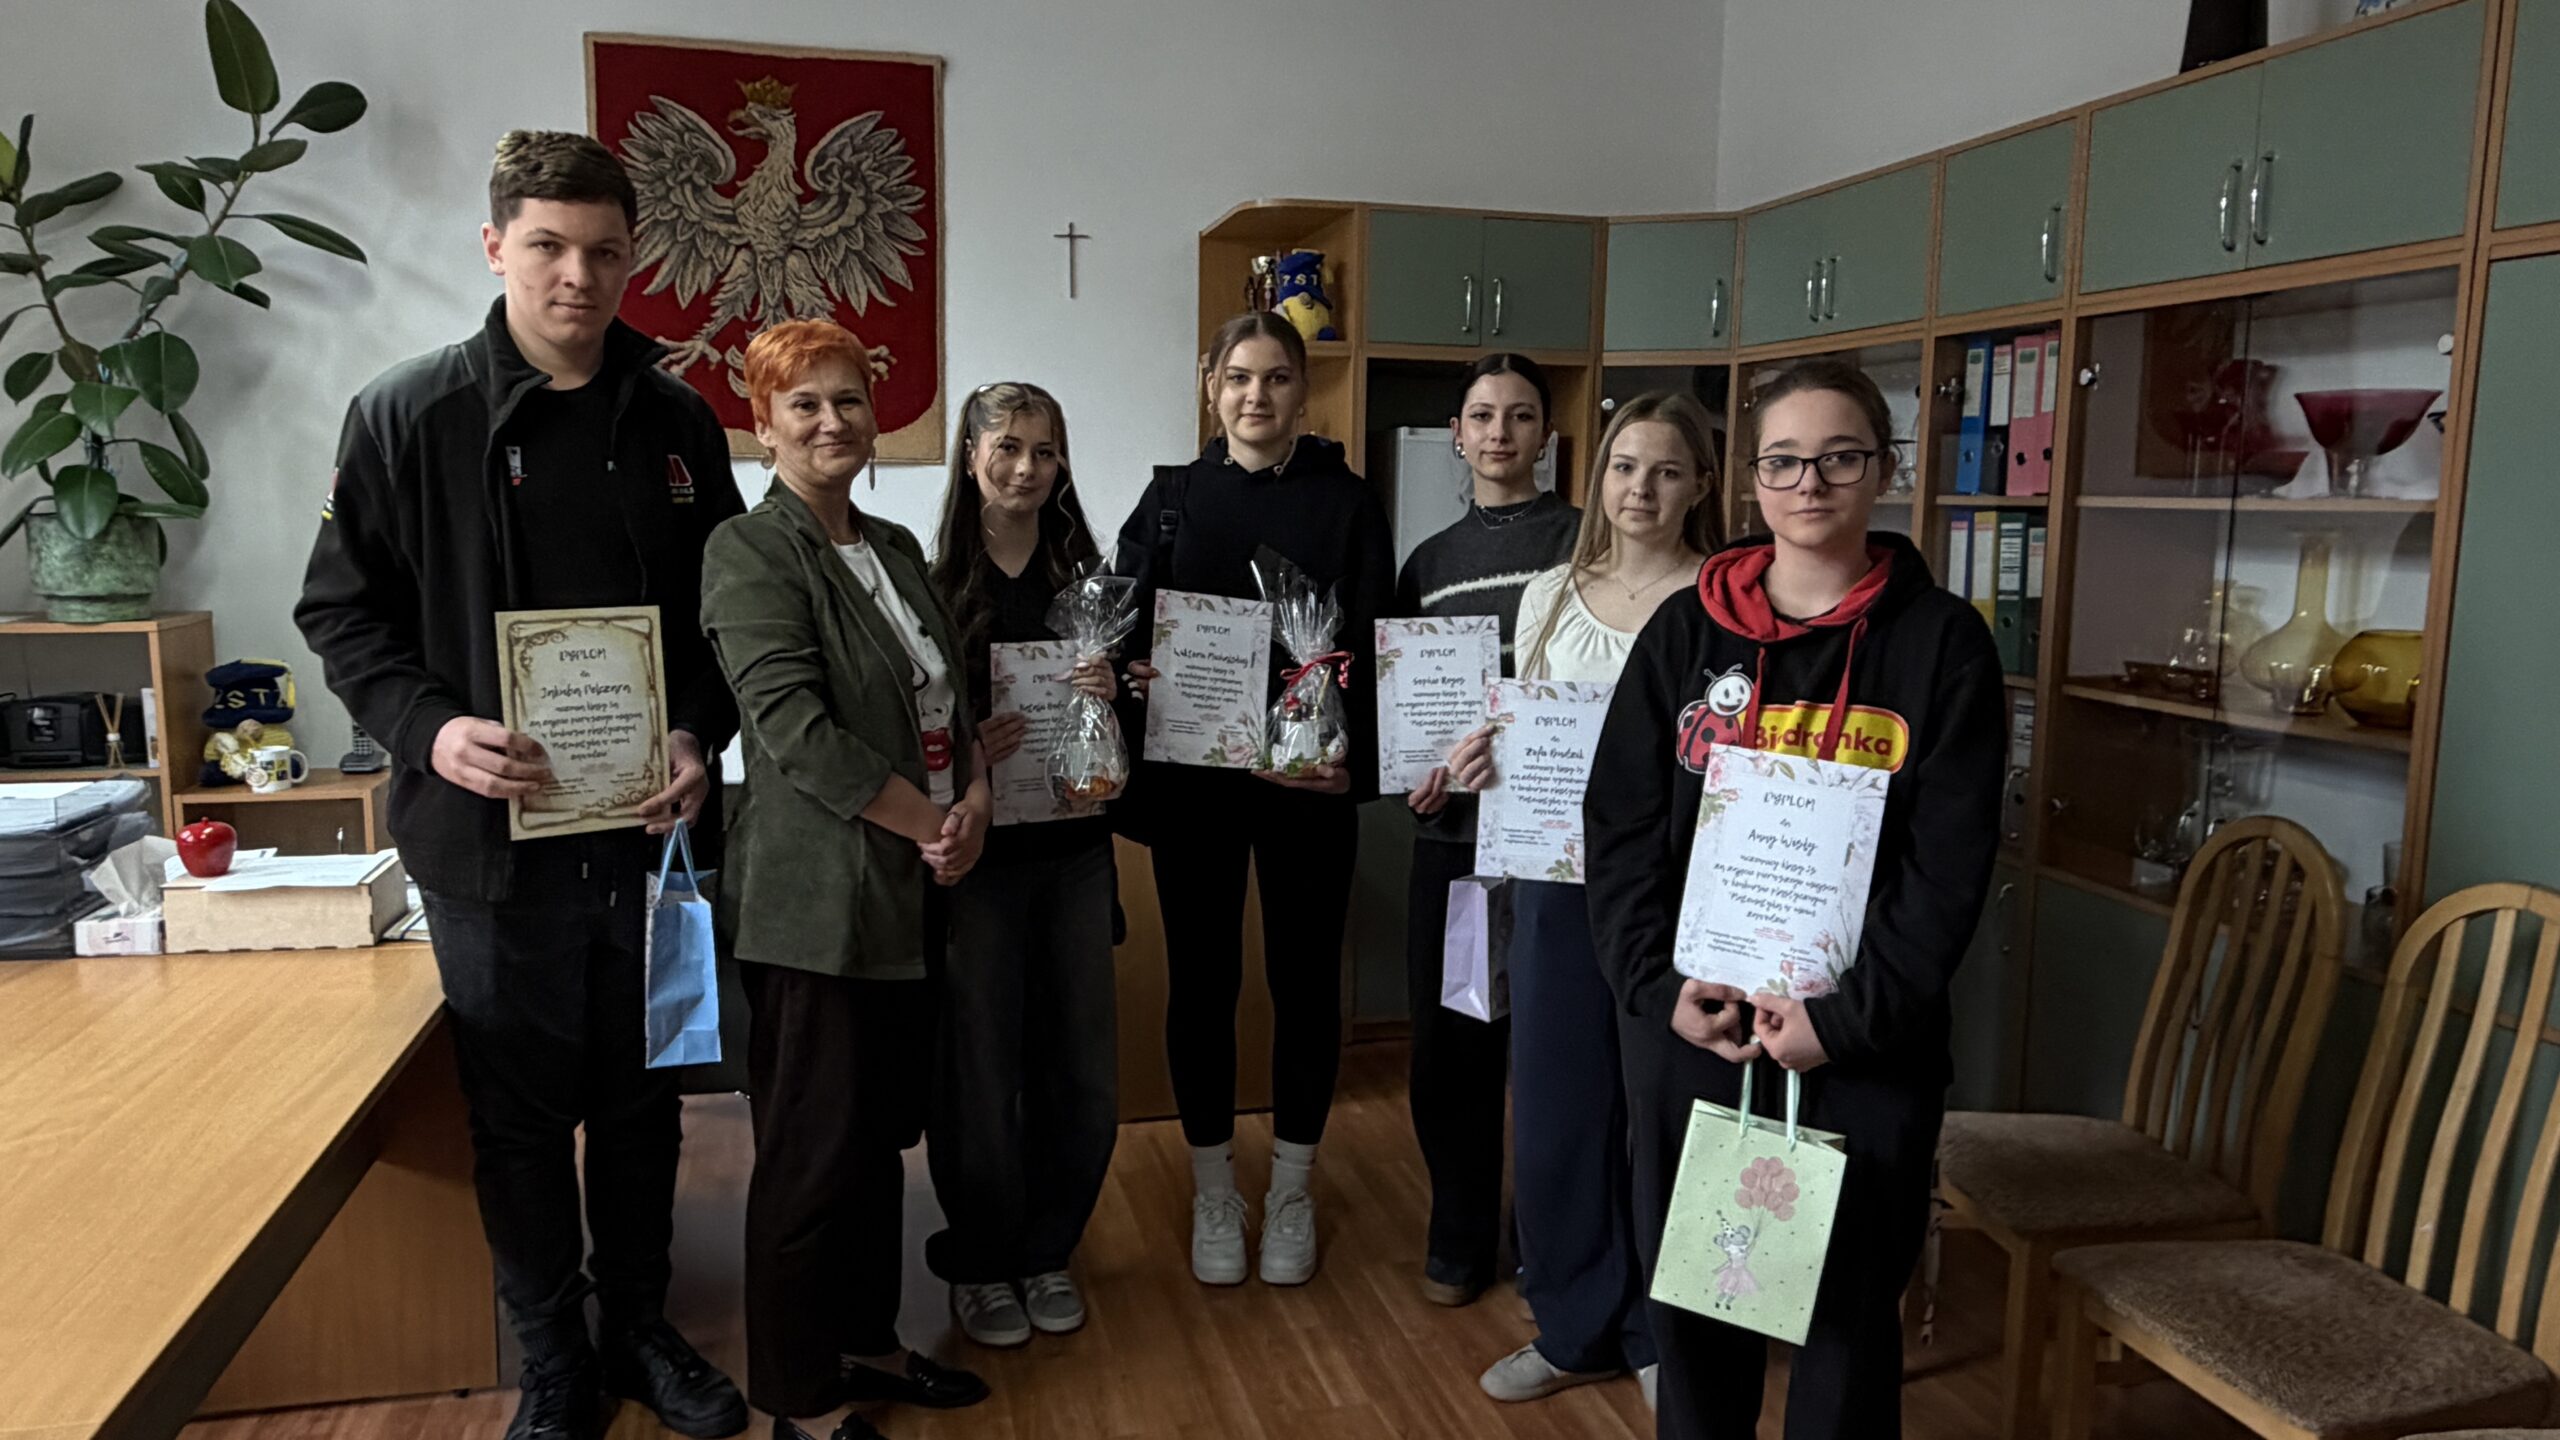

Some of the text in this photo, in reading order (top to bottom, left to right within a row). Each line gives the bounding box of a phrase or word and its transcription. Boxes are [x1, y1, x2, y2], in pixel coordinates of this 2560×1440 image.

[559, 647, 607, 662] DYPLOM
[1420, 648, 1456, 658] DYPLOM
[1535, 715, 1577, 729] DYPLOM
[1763, 791, 1816, 813] DYPLOM
